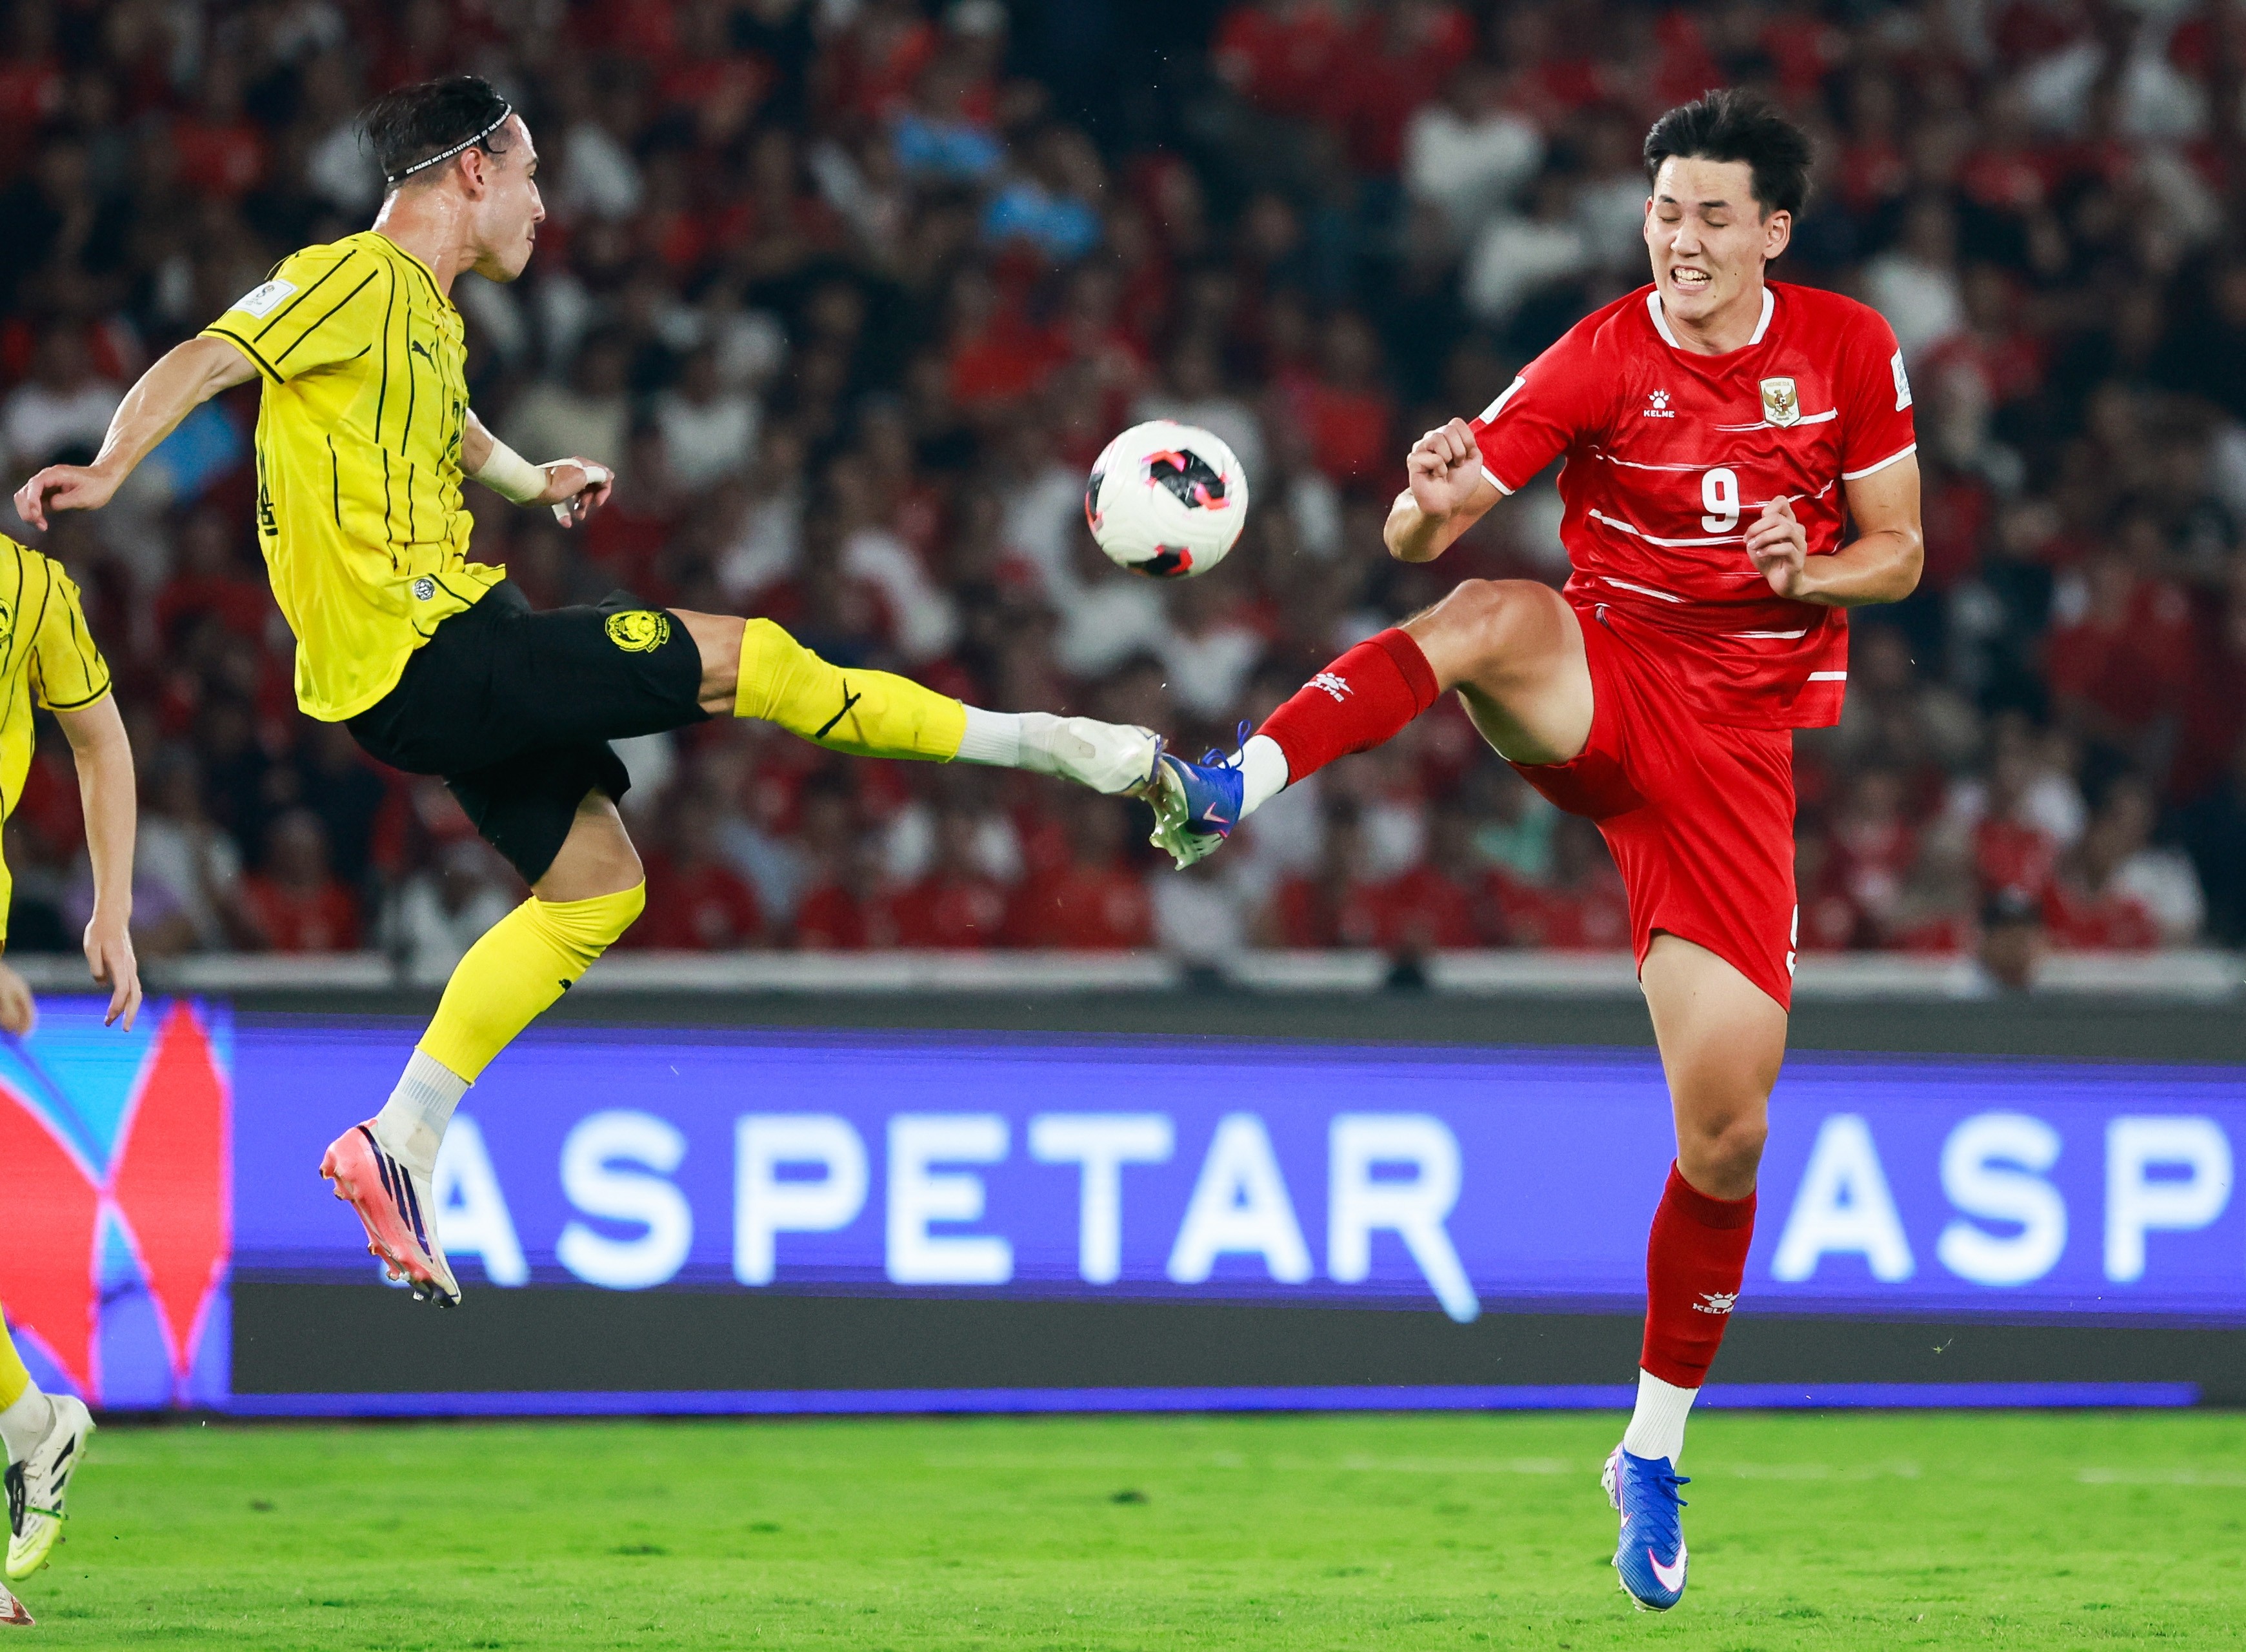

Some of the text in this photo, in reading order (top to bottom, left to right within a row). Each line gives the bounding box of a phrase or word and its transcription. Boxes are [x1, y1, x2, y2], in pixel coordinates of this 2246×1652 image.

[1643, 410, 1675, 418] KELME
[1701, 467, 1740, 533] 9
[381, 1108, 1480, 1323] ASPETAR
[1770, 1109, 2234, 1286] ASP
[1692, 1302, 1734, 1314] KELM
